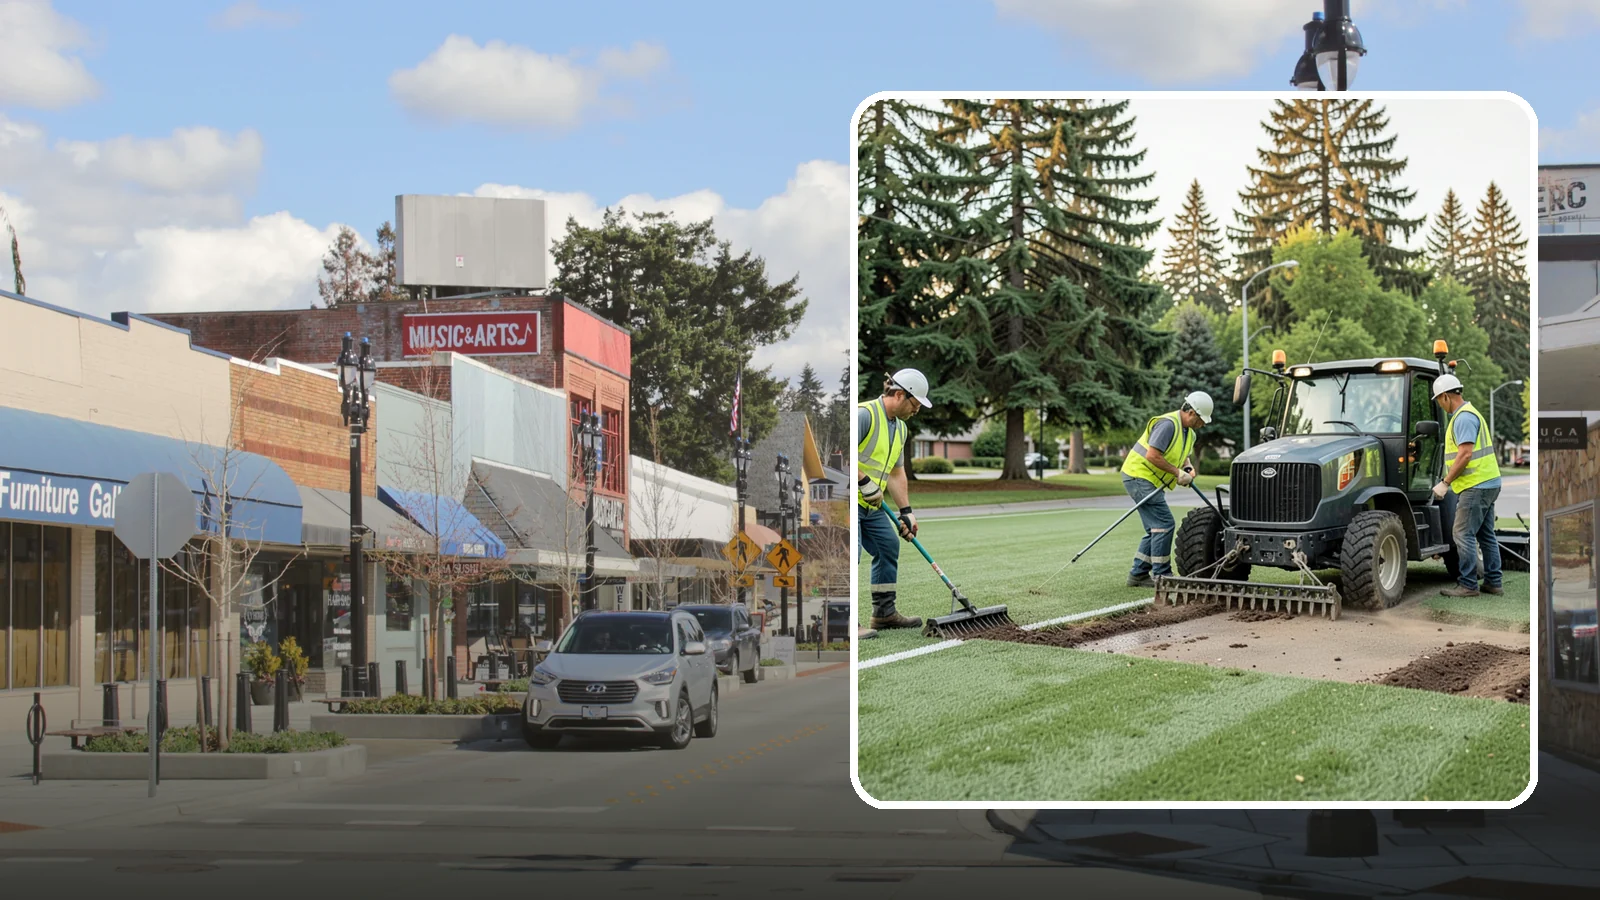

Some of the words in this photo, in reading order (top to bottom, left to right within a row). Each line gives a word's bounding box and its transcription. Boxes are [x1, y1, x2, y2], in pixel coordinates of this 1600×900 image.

[409, 323, 520, 349] MUSIC&ARTS
[1540, 427, 1578, 437] UGA
[0, 471, 79, 515] Furniture
[89, 482, 121, 519] Gal
[453, 563, 479, 574] SUSHI
